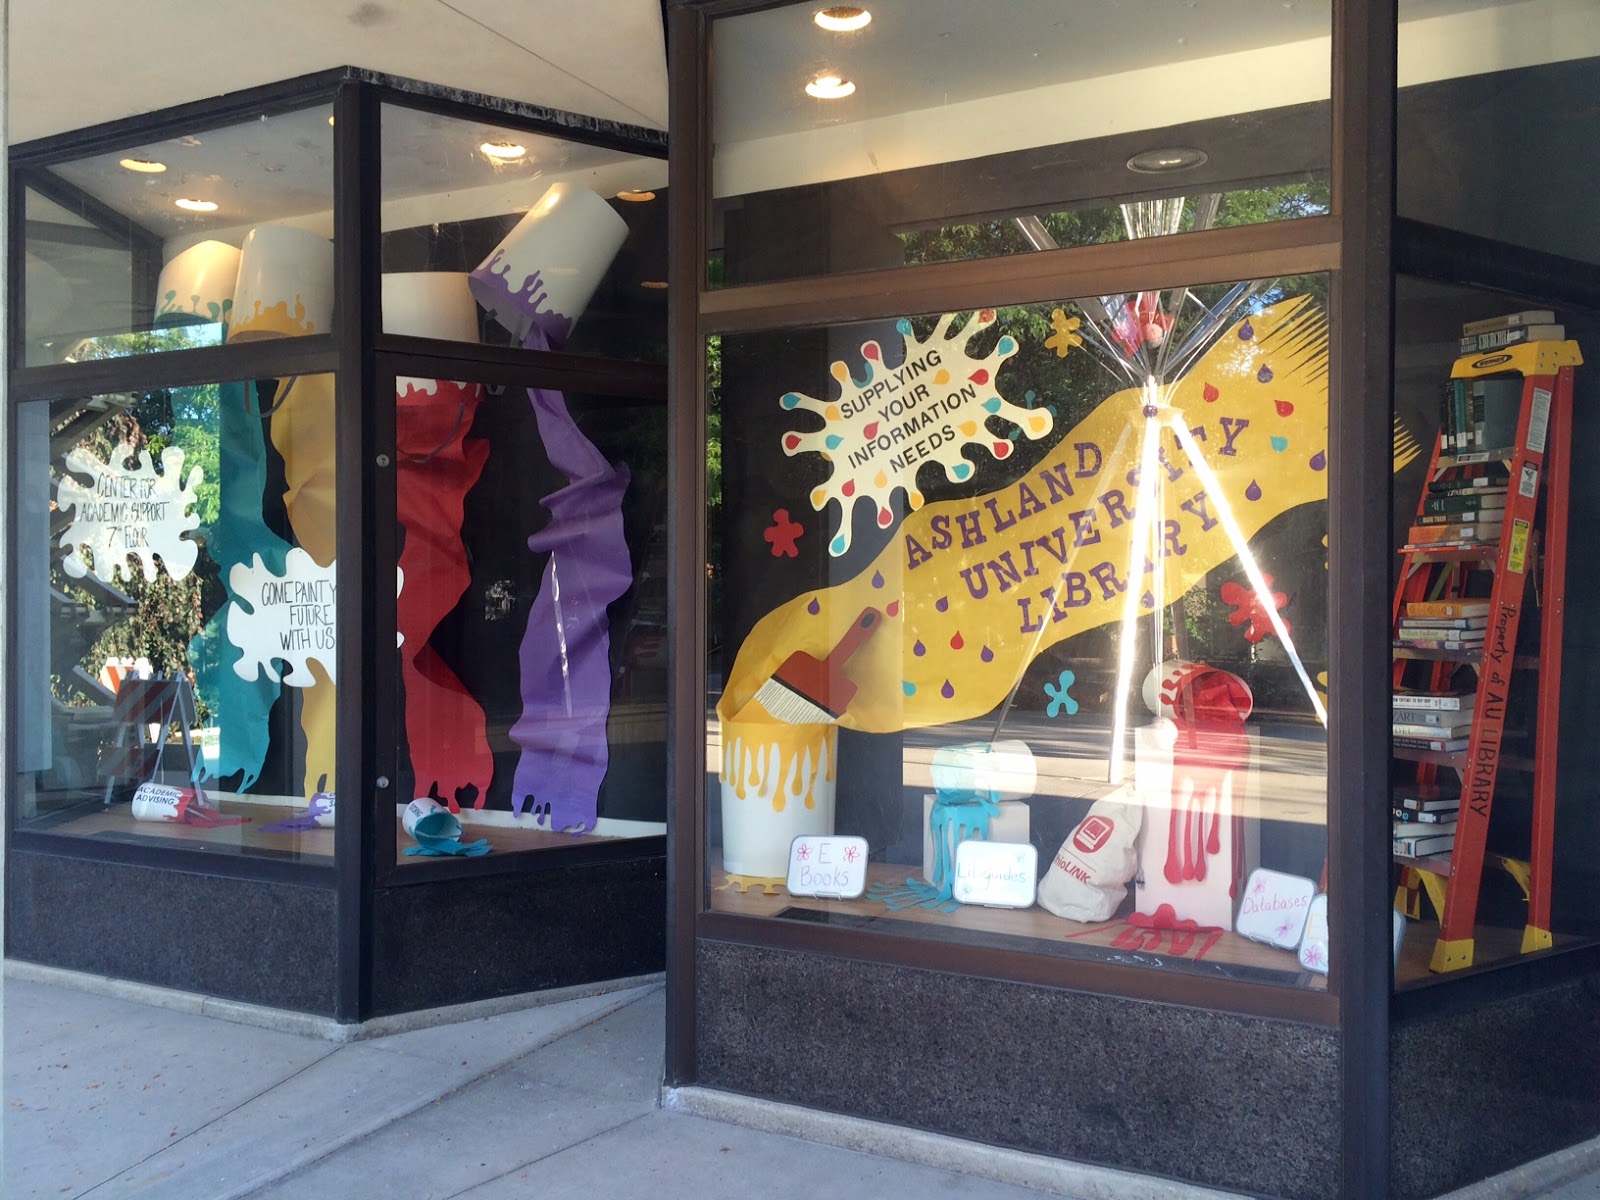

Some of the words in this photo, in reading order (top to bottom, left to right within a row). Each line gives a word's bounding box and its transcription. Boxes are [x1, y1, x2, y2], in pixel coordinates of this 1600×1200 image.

[840, 349, 942, 419] SUPPLYING
[878, 383, 930, 422] YOUR
[847, 383, 977, 469] INFORMATION
[889, 424, 956, 473] NEEDS
[97, 472, 138, 499] CENTER
[139, 477, 159, 499] FOR
[80, 502, 127, 523] ACADEMIC
[131, 501, 170, 523] SUPPORT
[904, 441, 1103, 570] ASHLAND
[124, 524, 150, 549] FLOOR
[1017, 489, 1219, 634] LIBRRY
[261, 580, 293, 606] COME
[294, 579, 330, 605] PAINT
[289, 603, 334, 626] FUTURE
[279, 628, 311, 651] WITH
[315, 626, 336, 650] US
[1489, 606, 1517, 664] Property
[1490, 671, 1506, 687] of
[1484, 691, 1504, 720] AU
[1469, 728, 1498, 818] LIBRARY
[136, 794, 175, 806] ADVISING
[137, 786, 182, 799] ACADEMIC
[819, 842, 832, 864] E
[800, 865, 849, 887] Books
[1055, 853, 1091, 885] hioLINK
[1243, 893, 1308, 914] Databases
